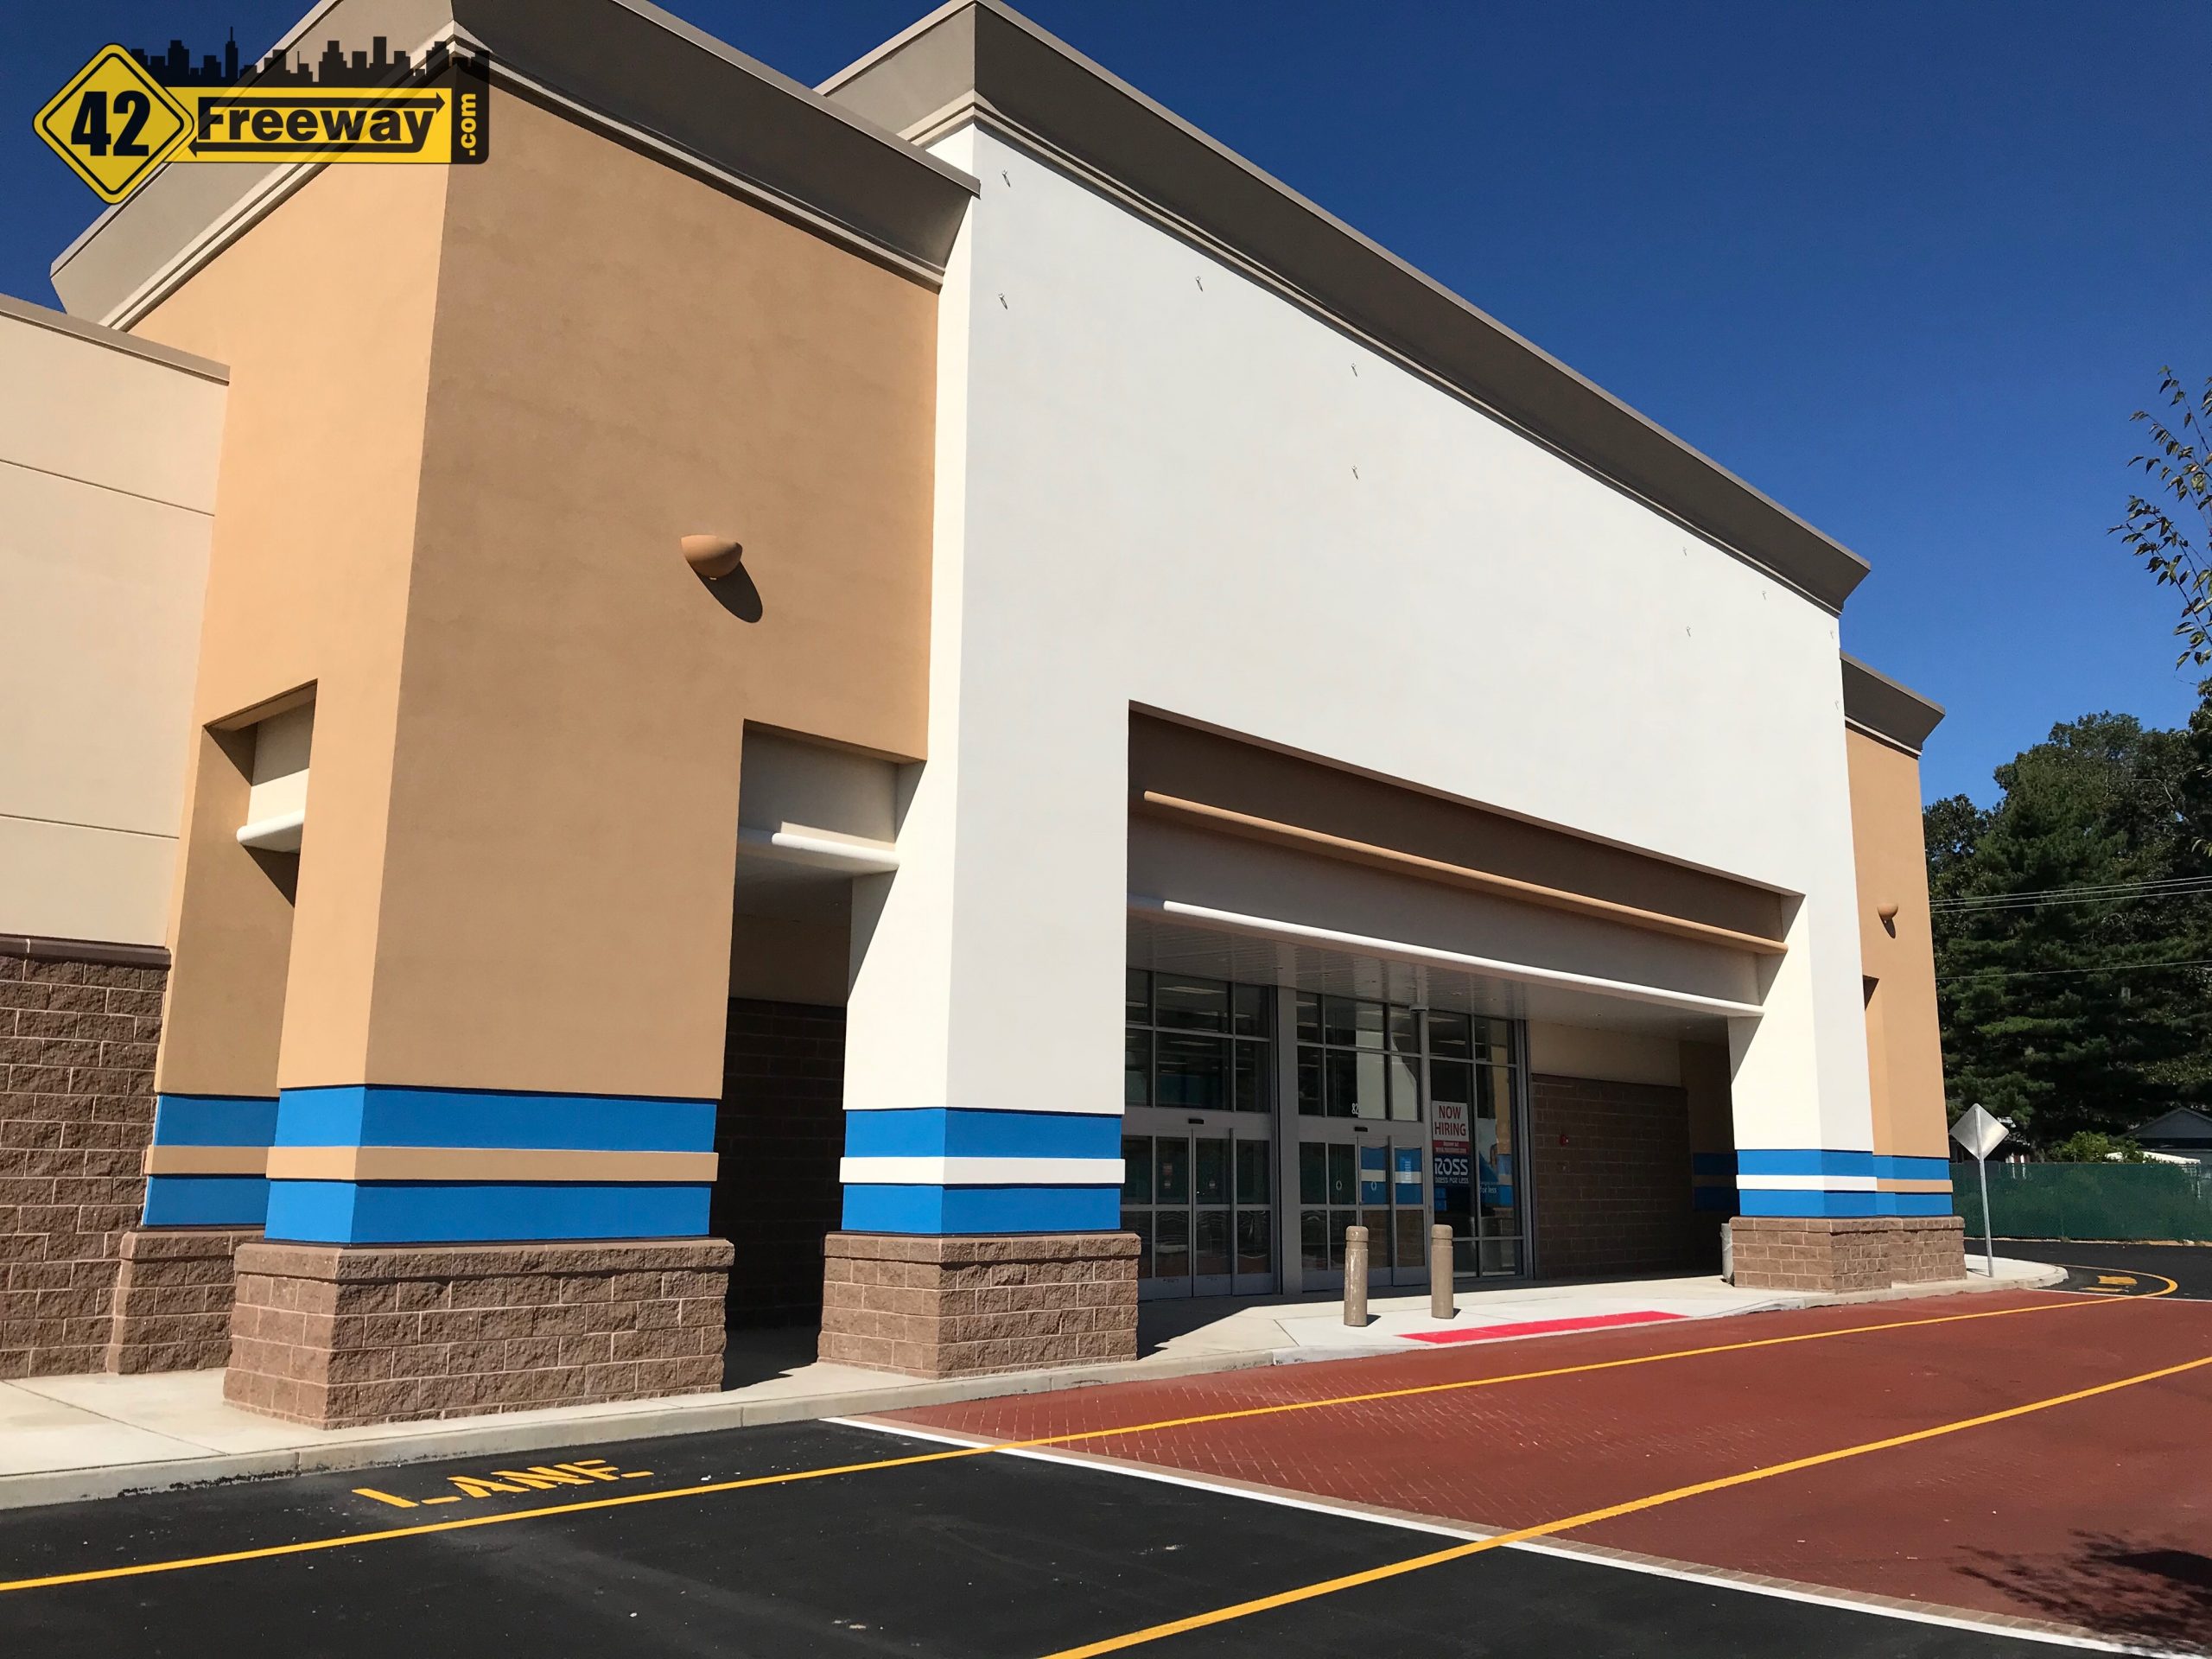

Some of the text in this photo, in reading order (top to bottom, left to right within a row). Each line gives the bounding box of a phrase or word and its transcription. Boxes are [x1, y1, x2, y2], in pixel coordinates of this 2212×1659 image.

[1439, 1105, 1461, 1119] NOW
[1434, 1122, 1466, 1136] HIRING
[1434, 1158, 1468, 1175] ROSS
